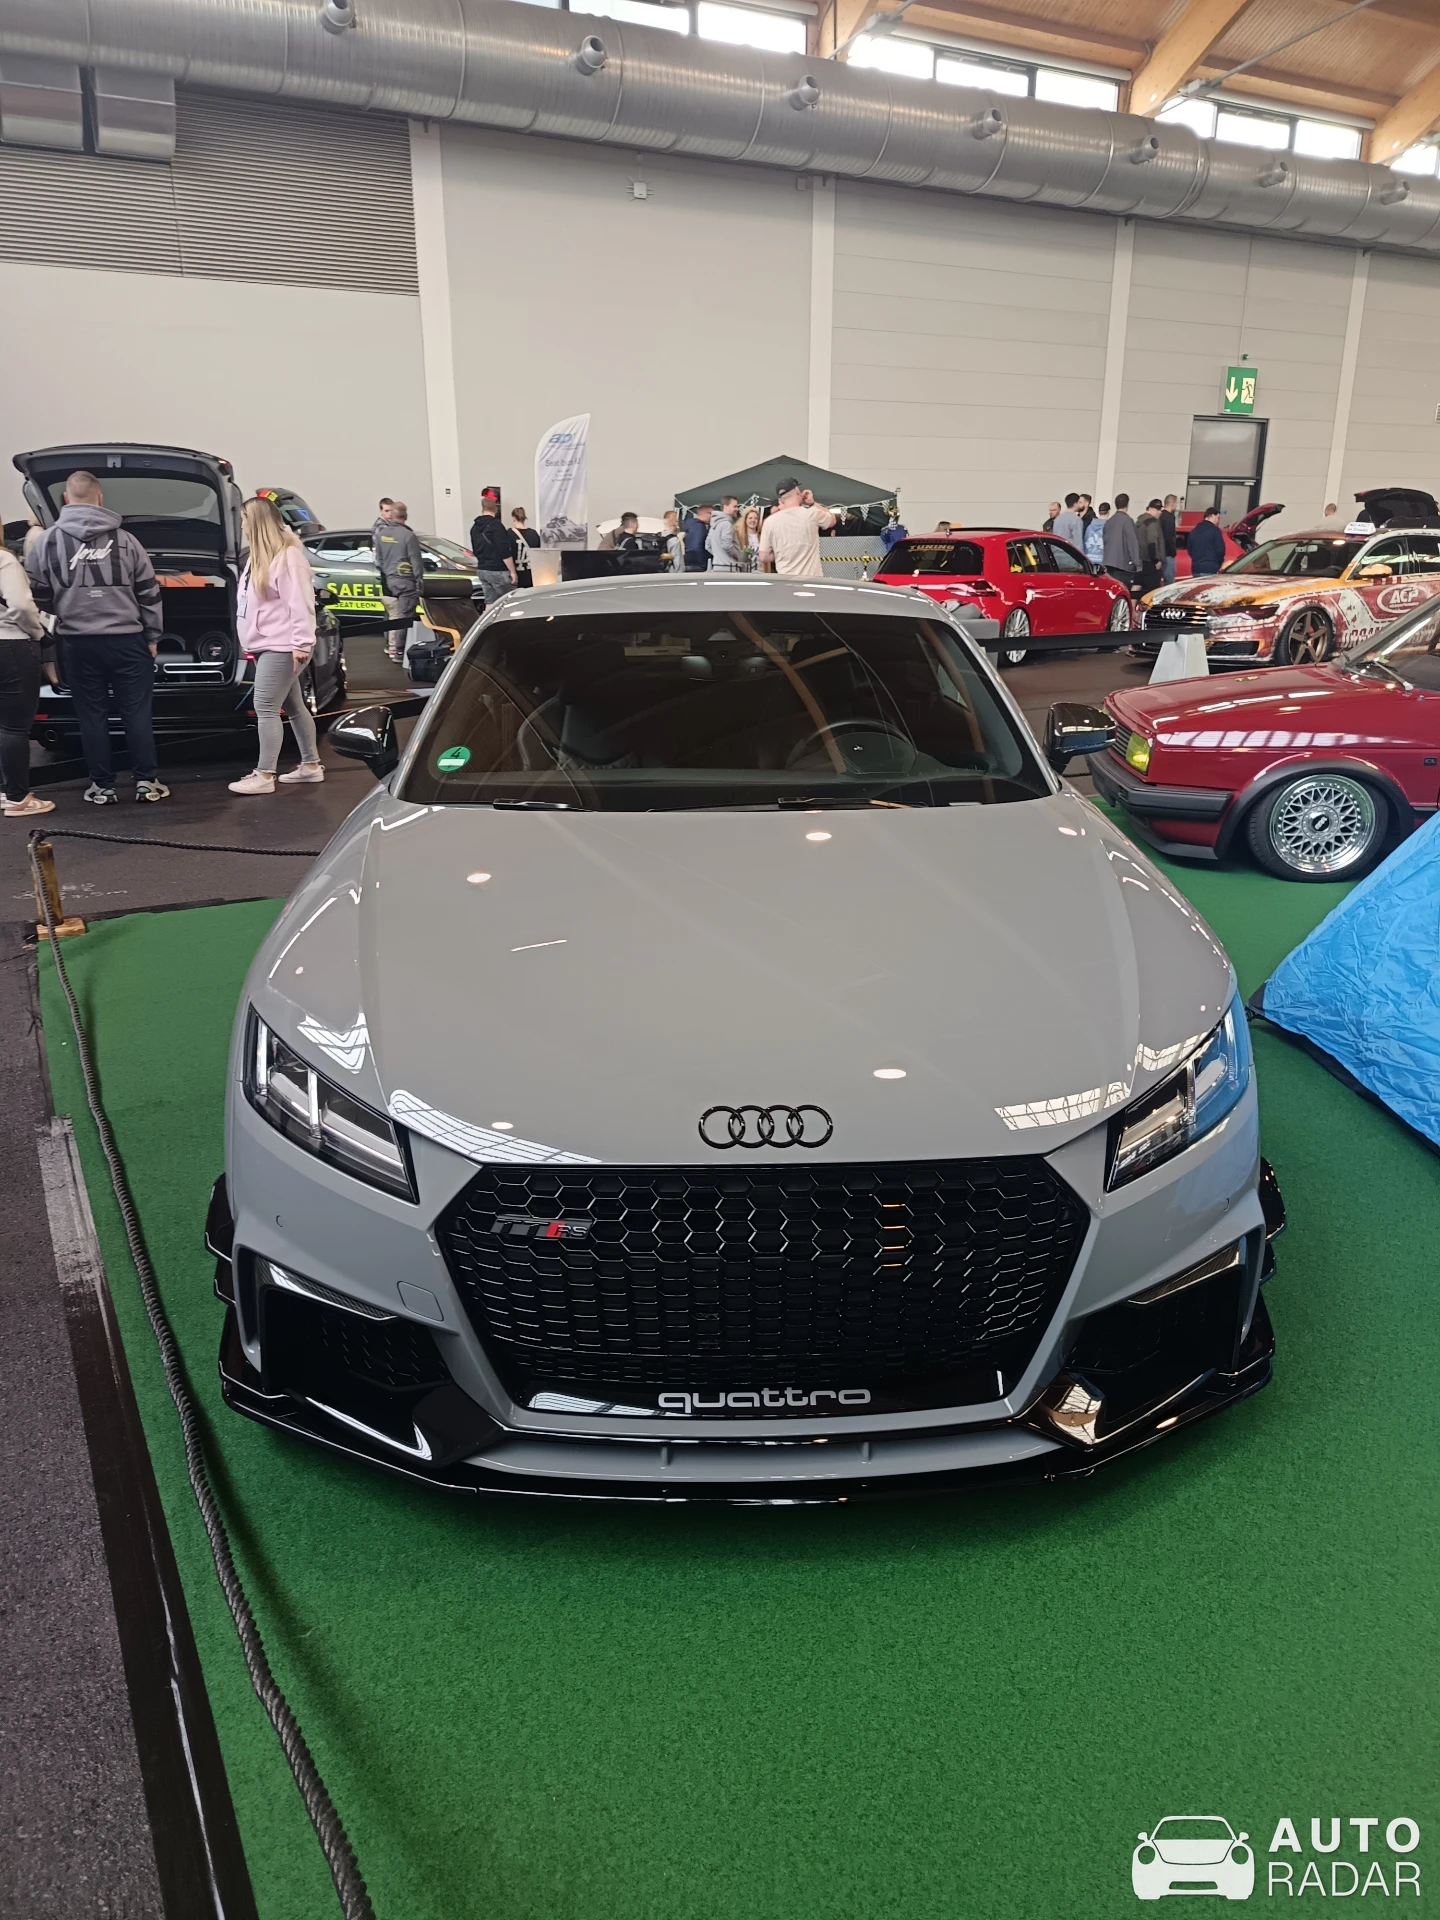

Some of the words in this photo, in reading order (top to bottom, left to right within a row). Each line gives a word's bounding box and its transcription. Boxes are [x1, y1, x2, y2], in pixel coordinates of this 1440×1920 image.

[356, 601, 376, 609] LEON
[451, 747, 461, 759] 4
[658, 1387, 871, 1413] quattro
